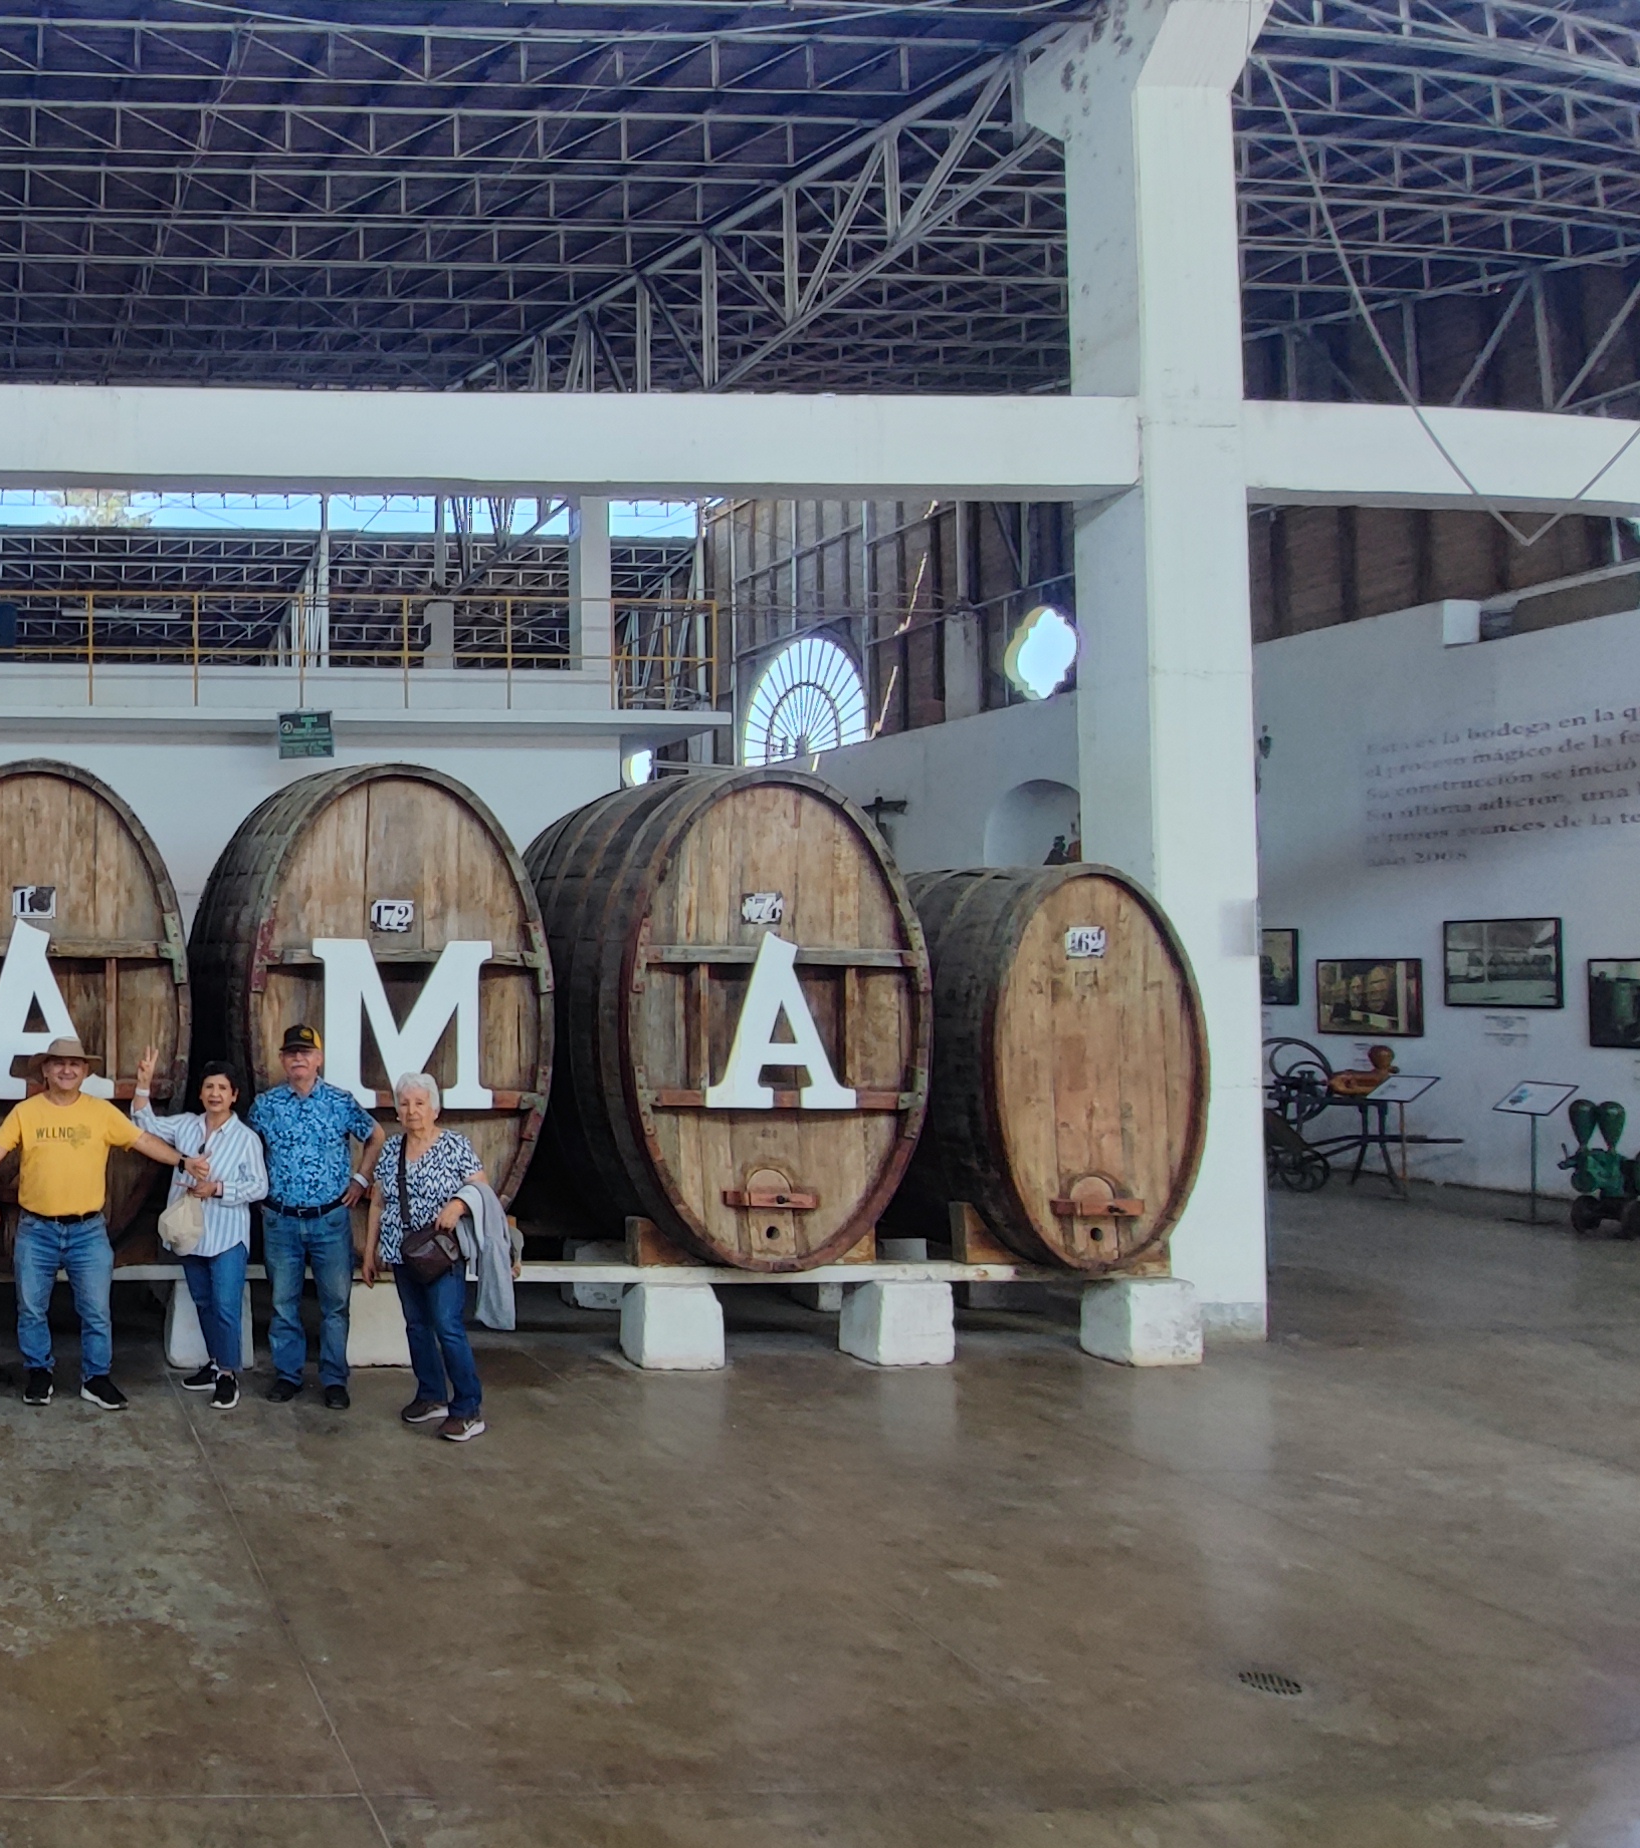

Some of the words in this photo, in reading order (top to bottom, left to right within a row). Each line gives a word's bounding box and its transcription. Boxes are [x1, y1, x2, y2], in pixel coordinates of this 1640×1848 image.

[1467, 721, 1551, 740] bodega
[1558, 715, 1587, 730] en
[1595, 708, 1615, 723] la
[1623, 705, 1640, 724] q
[1472, 745, 1553, 765] mágico
[1559, 737, 1587, 754] de
[1593, 733, 1613, 749] la
[1395, 770, 1534, 798] construcción
[1540, 768, 1563, 781] se
[1570, 755, 1637, 779] inició
[1581, 787, 1629, 803] una
[1553, 814, 1582, 830] de
[1591, 811, 1611, 826] la
[376, 905, 410, 927] 172
